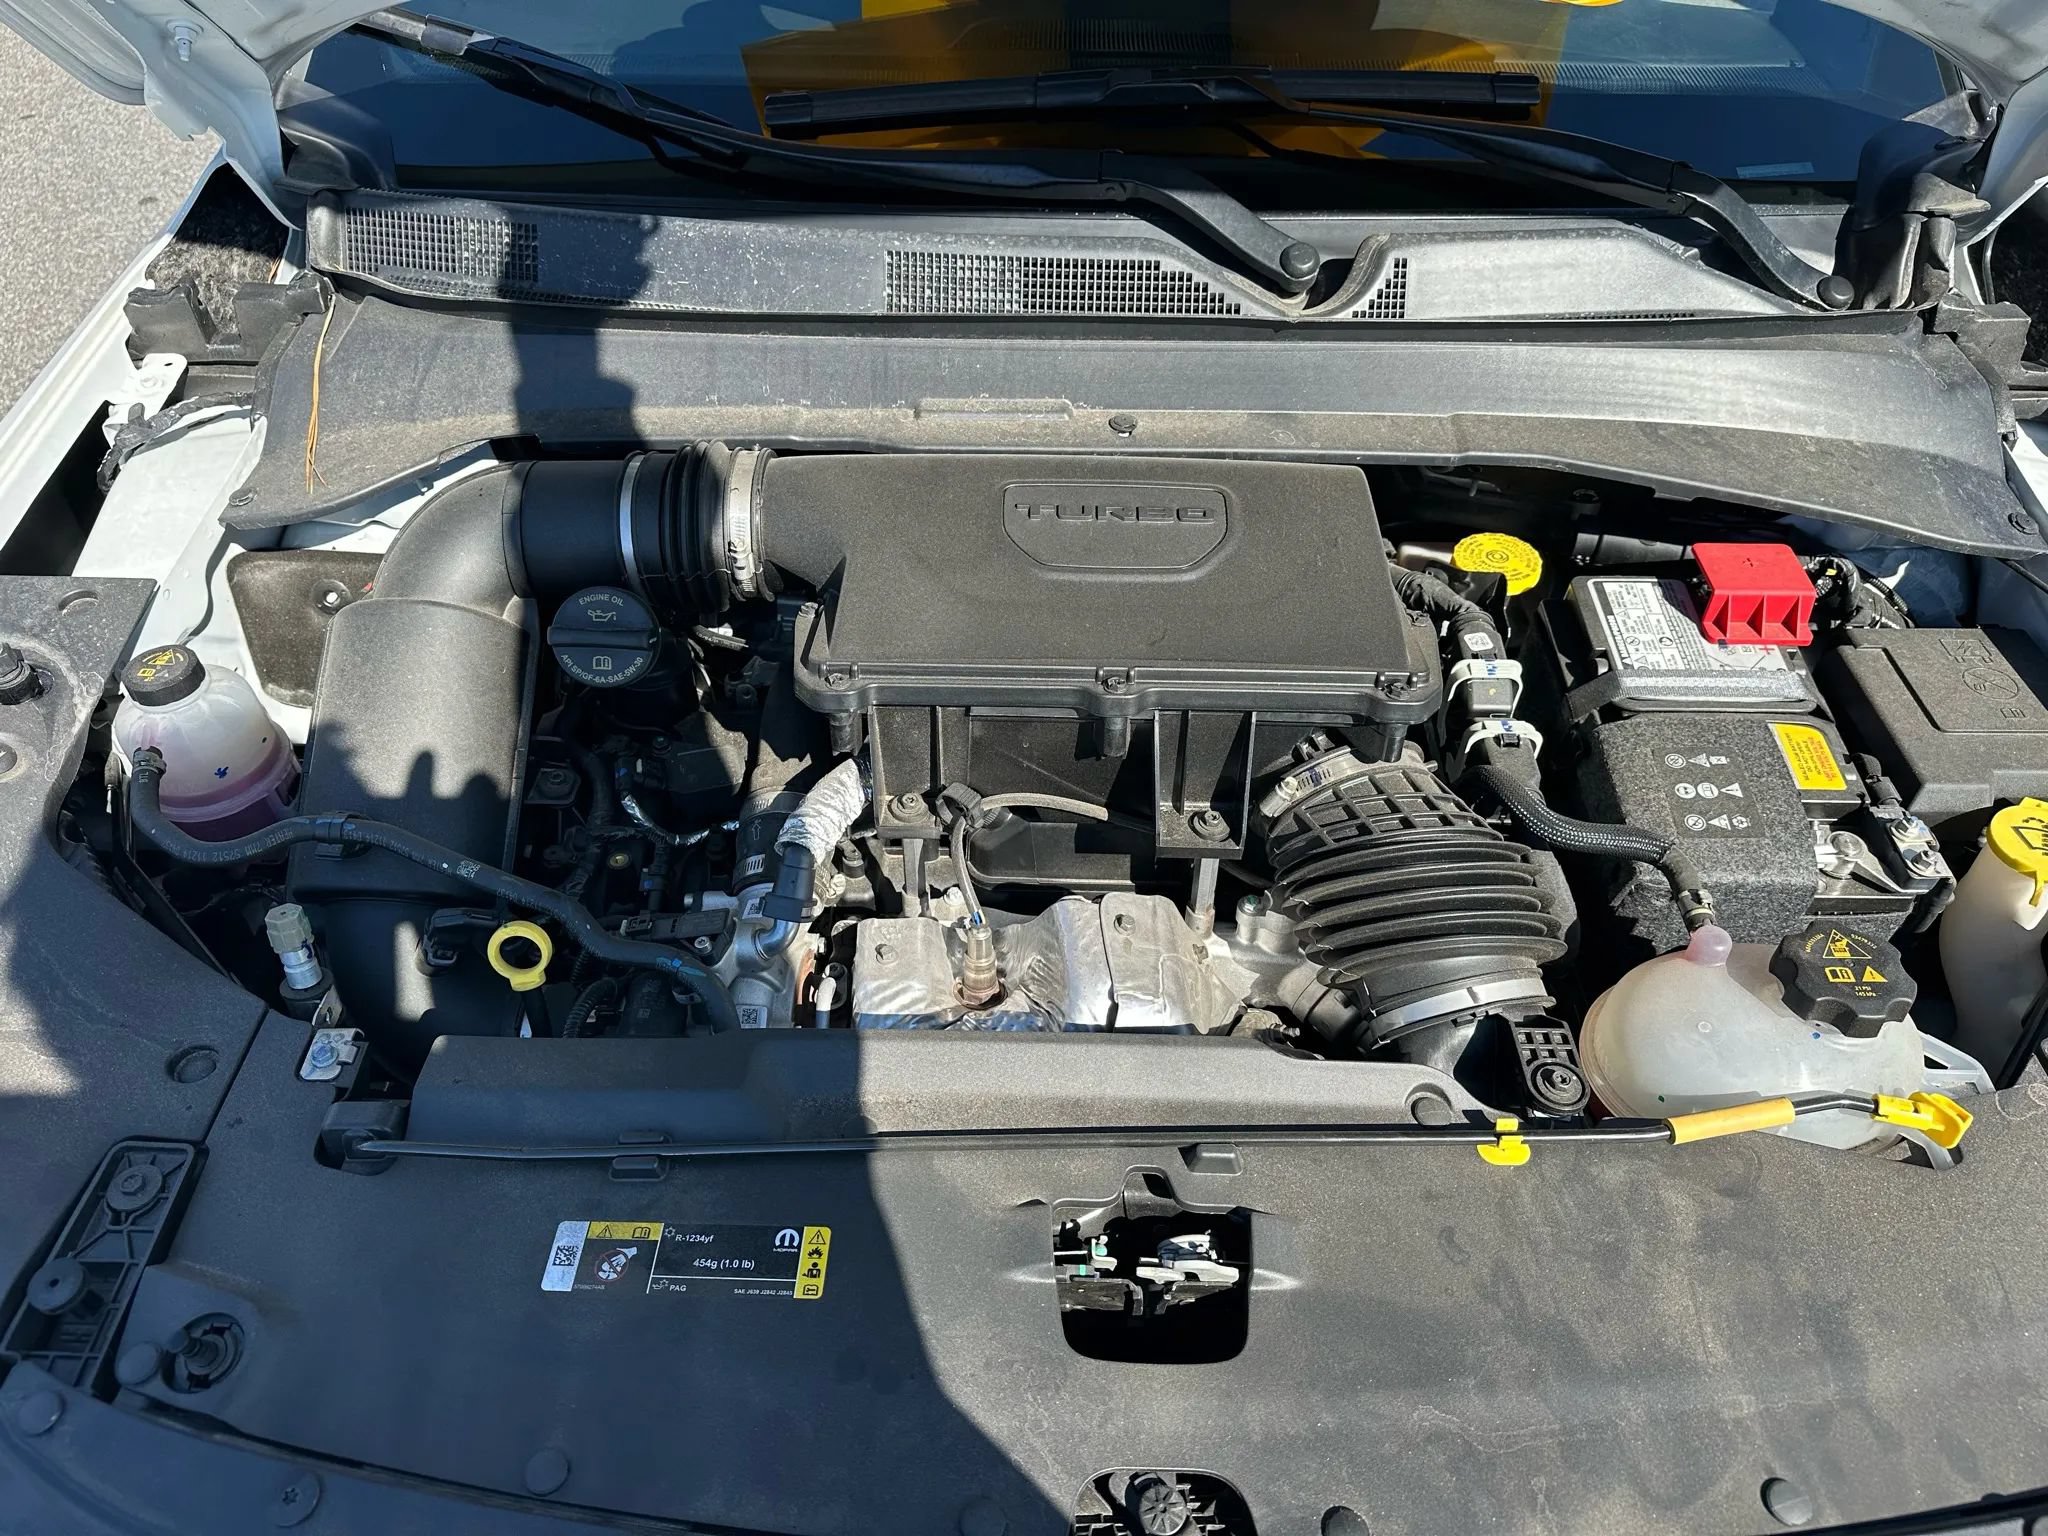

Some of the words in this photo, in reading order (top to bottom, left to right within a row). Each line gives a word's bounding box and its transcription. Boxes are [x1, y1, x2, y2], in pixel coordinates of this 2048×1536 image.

[1014, 503, 1216, 525] TURBO
[579, 593, 610, 606] ENGINE
[611, 595, 625, 607] OIL
[560, 654, 574, 668] API
[264, 828, 294, 848] HEATER
[675, 1233, 715, 1244] R-1234yf
[692, 1258, 718, 1269] 454g
[720, 1259, 739, 1270] (1.0
[741, 1259, 755, 1271] lb)
[669, 1284, 687, 1292] PAG
